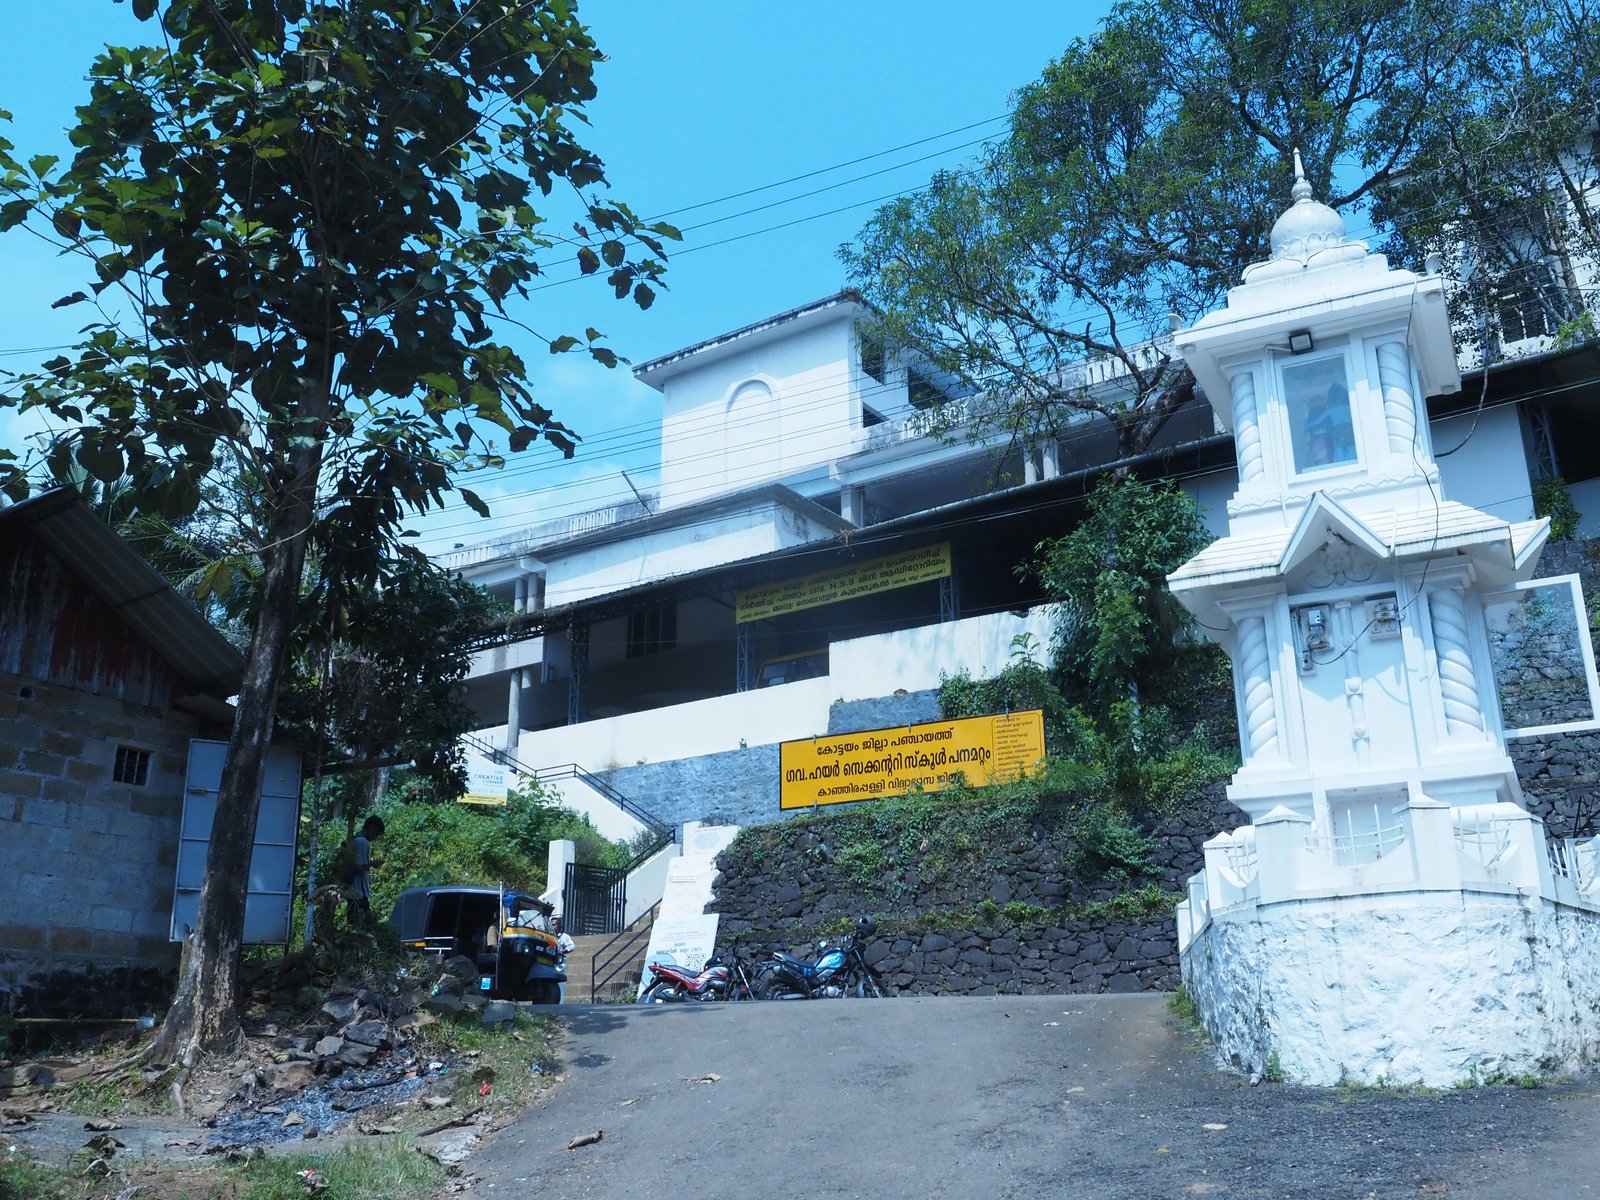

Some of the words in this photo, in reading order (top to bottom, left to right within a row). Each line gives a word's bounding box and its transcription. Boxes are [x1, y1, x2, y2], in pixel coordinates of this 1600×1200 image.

[817, 742, 859, 756] കോട്ടയം
[862, 738, 888, 752] ജില്ലാ
[891, 727, 954, 747] പഞ്ചായത്ത്
[786, 768, 808, 782] ഗവ.
[809, 760, 840, 780] ഹയർ
[904, 747, 947, 770] സ്കൂൾ
[949, 746, 991, 766] പനമറ്റം
[818, 779, 885, 797] കാഞ്ഞിരപ്പള്ളി
